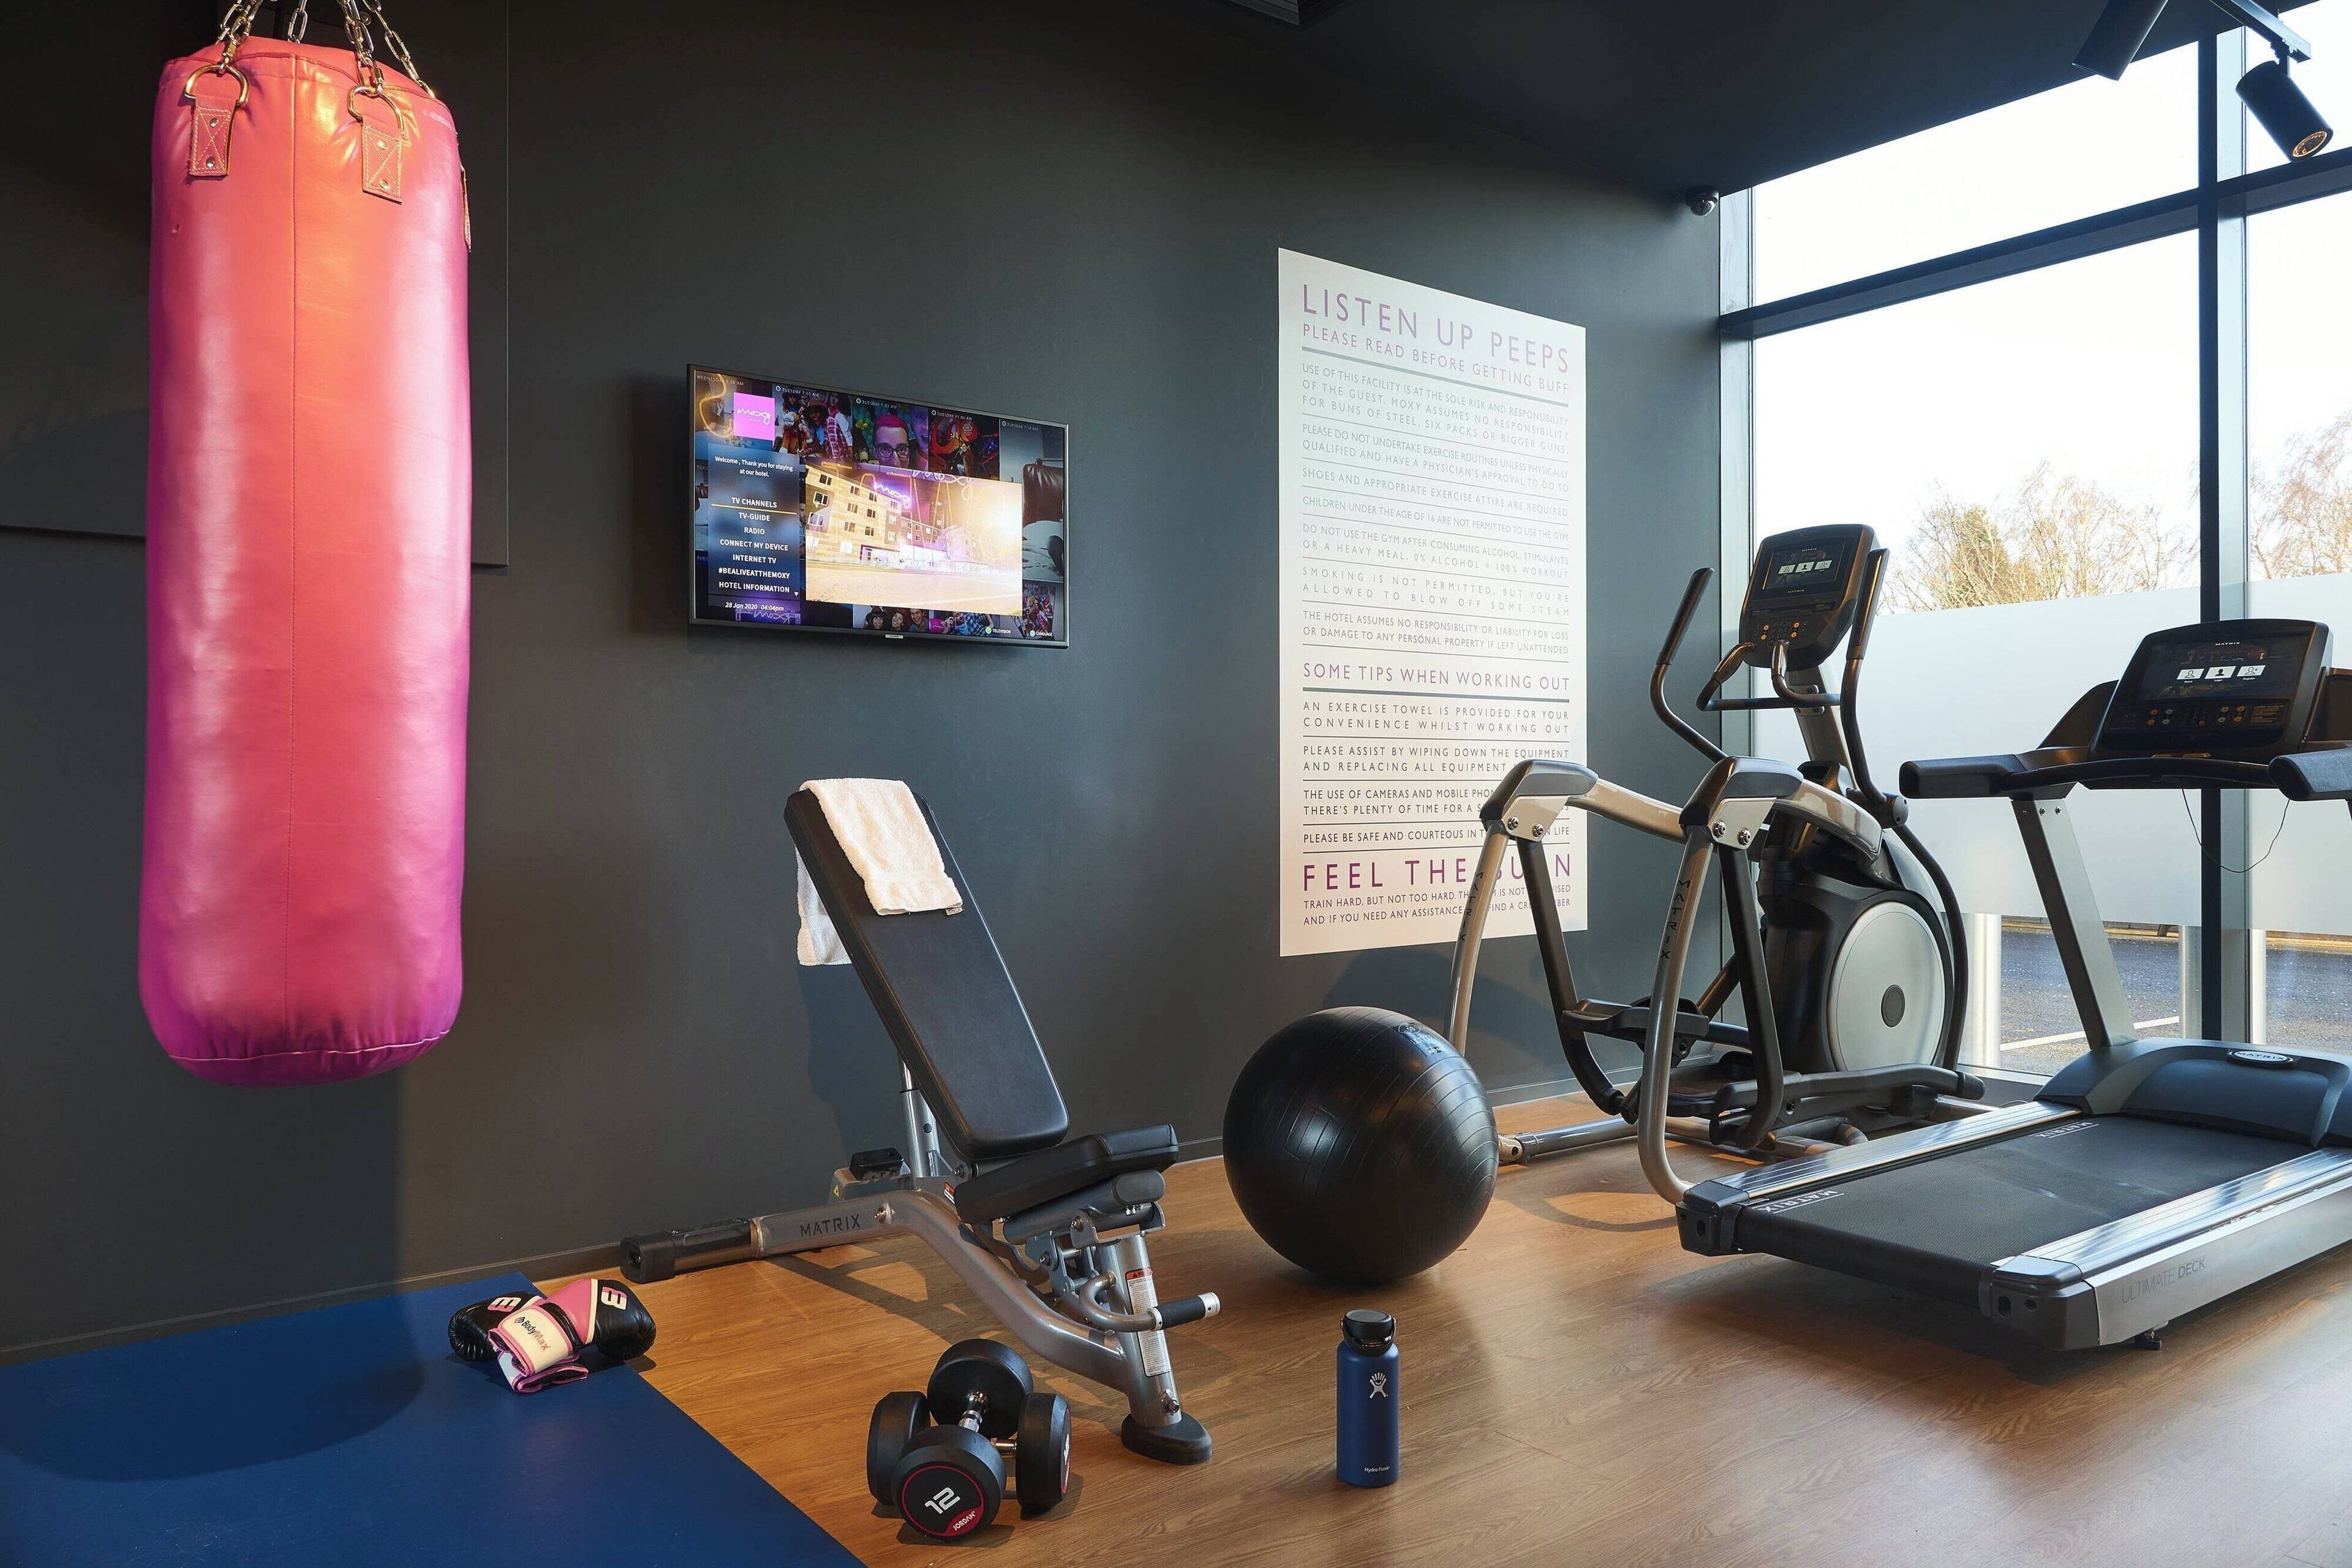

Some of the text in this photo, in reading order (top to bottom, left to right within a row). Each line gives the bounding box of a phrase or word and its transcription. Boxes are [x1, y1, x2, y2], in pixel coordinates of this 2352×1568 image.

[1303, 284, 1567, 373] LISTEN UP PEEPS
[1303, 323, 1567, 394] PLEASE READ BEFORE GETTING BUFF
[775, 464, 793, 472] staying
[742, 498, 777, 508] CHANNELS
[739, 512, 771, 521] TV-GUIDE
[720, 538, 752, 547] CONNECT
[765, 543, 788, 551] DEVICE
[733, 554, 766, 563] INTERNET
[718, 567, 790, 579] #BEALIVEATTHEMOXY
[743, 583, 790, 593] INFORMATION
[1303, 609, 1568, 640] THE HOTEL ASSUMES NO RESPONSIBILITY OR LIABILITY FOR LOSS
[1303, 626, 1568, 654] OR DAMAGE TO ANY PERSONAL PROPERTY IF LEFT UNATTENDED
[1303, 662, 1569, 690] SOME TIPS WHEN WORKING OUT
[1303, 701, 1568, 720] AN EXERCISE TOWEL IS PROVIDED FOR YOUR
[1303, 717, 1568, 733] CONVENIENCE WHILST WORKING OUT
[1303, 745, 1569, 759] PLEASE ASSIST BY WIPING DOWN THE EQUIPMENT
[1303, 761, 1506, 773] AND REPLACING ALL EQUIPMENT
[1303, 790, 1322, 799] THE
[1327, 789, 1344, 799] USE
[1348, 789, 1361, 799] OF
[1365, 789, 1409, 799] CAMERAS
[1412, 789, 1432, 798] AND
[1436, 788, 1468, 798] MOBILE
[1303, 805, 1348, 815] THERE'S
[1353, 804, 1392, 815] PLENTY
[1398, 804, 1411, 813] OF
[1415, 804, 1438, 813] TIME
[1444, 804, 1462, 813] FOR
[1466, 804, 1472, 812] A
[1303, 833, 1338, 843] PLEASE
[1342, 832, 1353, 842] BE
[1357, 832, 1379, 842] SAFE
[1382, 831, 1403, 840] AND
[1408, 829, 1463, 840] COURTEOUS
[1467, 829, 1476, 838] IN
[1303, 854, 1569, 891] FEEL THE UN
[1303, 899, 1332, 909] TRAIN
[1336, 897, 1363, 907] HARD,
[1366, 895, 1384, 905] BUT
[1387, 894, 1406, 903] NOT
[1409, 892, 1427, 902] TOO
[1431, 891, 1456, 900] HARD.
[1509, 888, 1525, 896] NOT
[1303, 912, 1324, 925] AND
[1329, 914, 1336, 923] IF
[1339, 912, 1359, 922] YOU
[1363, 911, 1387, 921] NEED
[1390, 909, 1409, 919] ANY
[1411, 905, 1462, 917] ASSISTANCE
[1660, 880, 1691, 959] MATRIX
[2237, 1052, 2283, 1060] MATRIX
[2035, 1121, 2093, 1137] MATRIX
[1758, 1190, 1838, 1212] MATRIX
[800, 1214, 861, 1237] MATRIX
[2122, 1257, 2205, 1303] ULTIMATE DECK
[925, 1487, 960, 1514] 12
